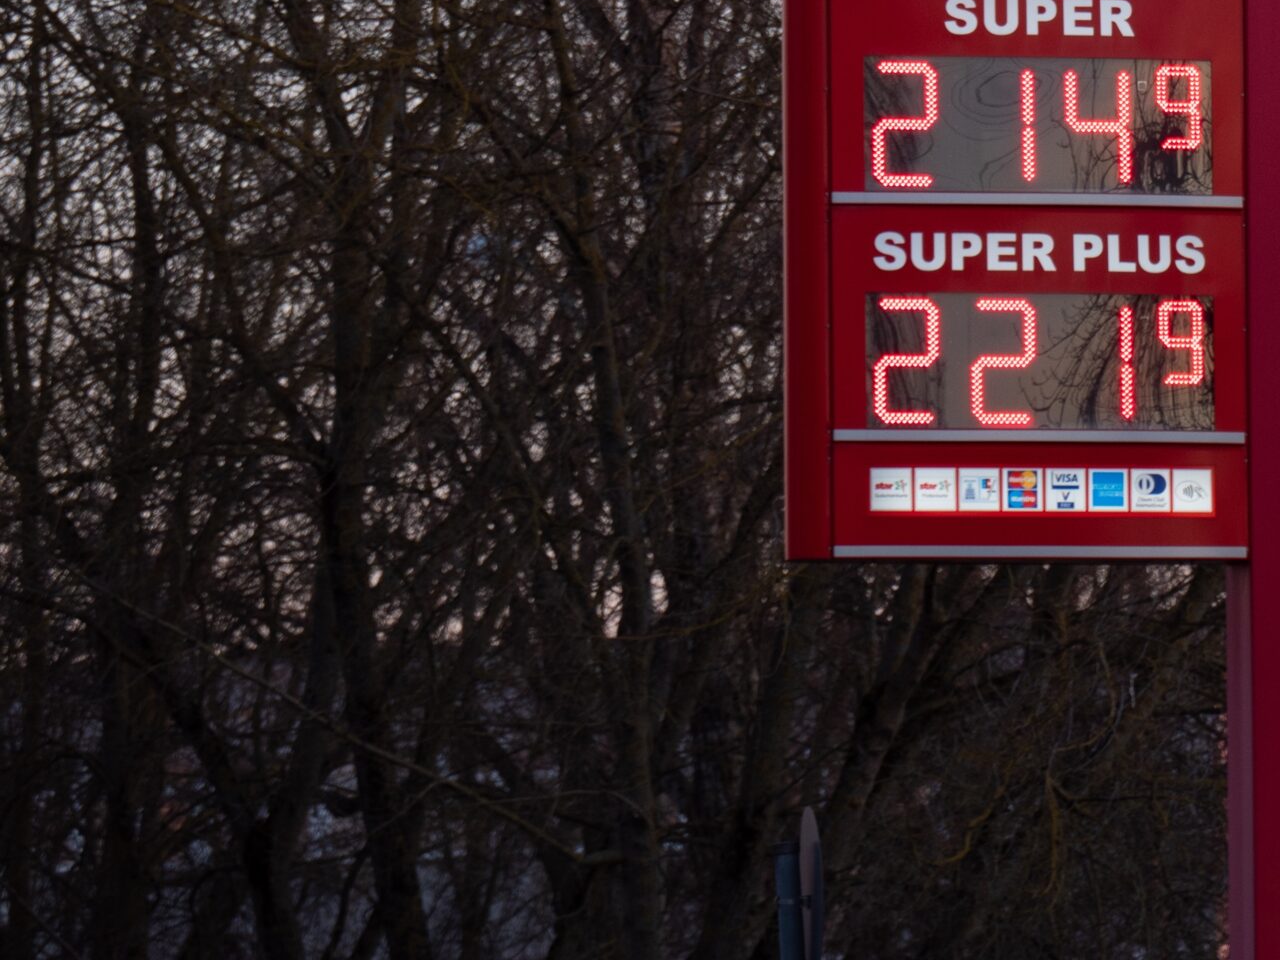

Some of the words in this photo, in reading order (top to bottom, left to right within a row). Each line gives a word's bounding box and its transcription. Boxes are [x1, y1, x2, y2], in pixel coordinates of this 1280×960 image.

[873, 231, 1057, 272] SUPER
[1072, 233, 1206, 275] PLUS
[1055, 473, 1078, 483] VISA
